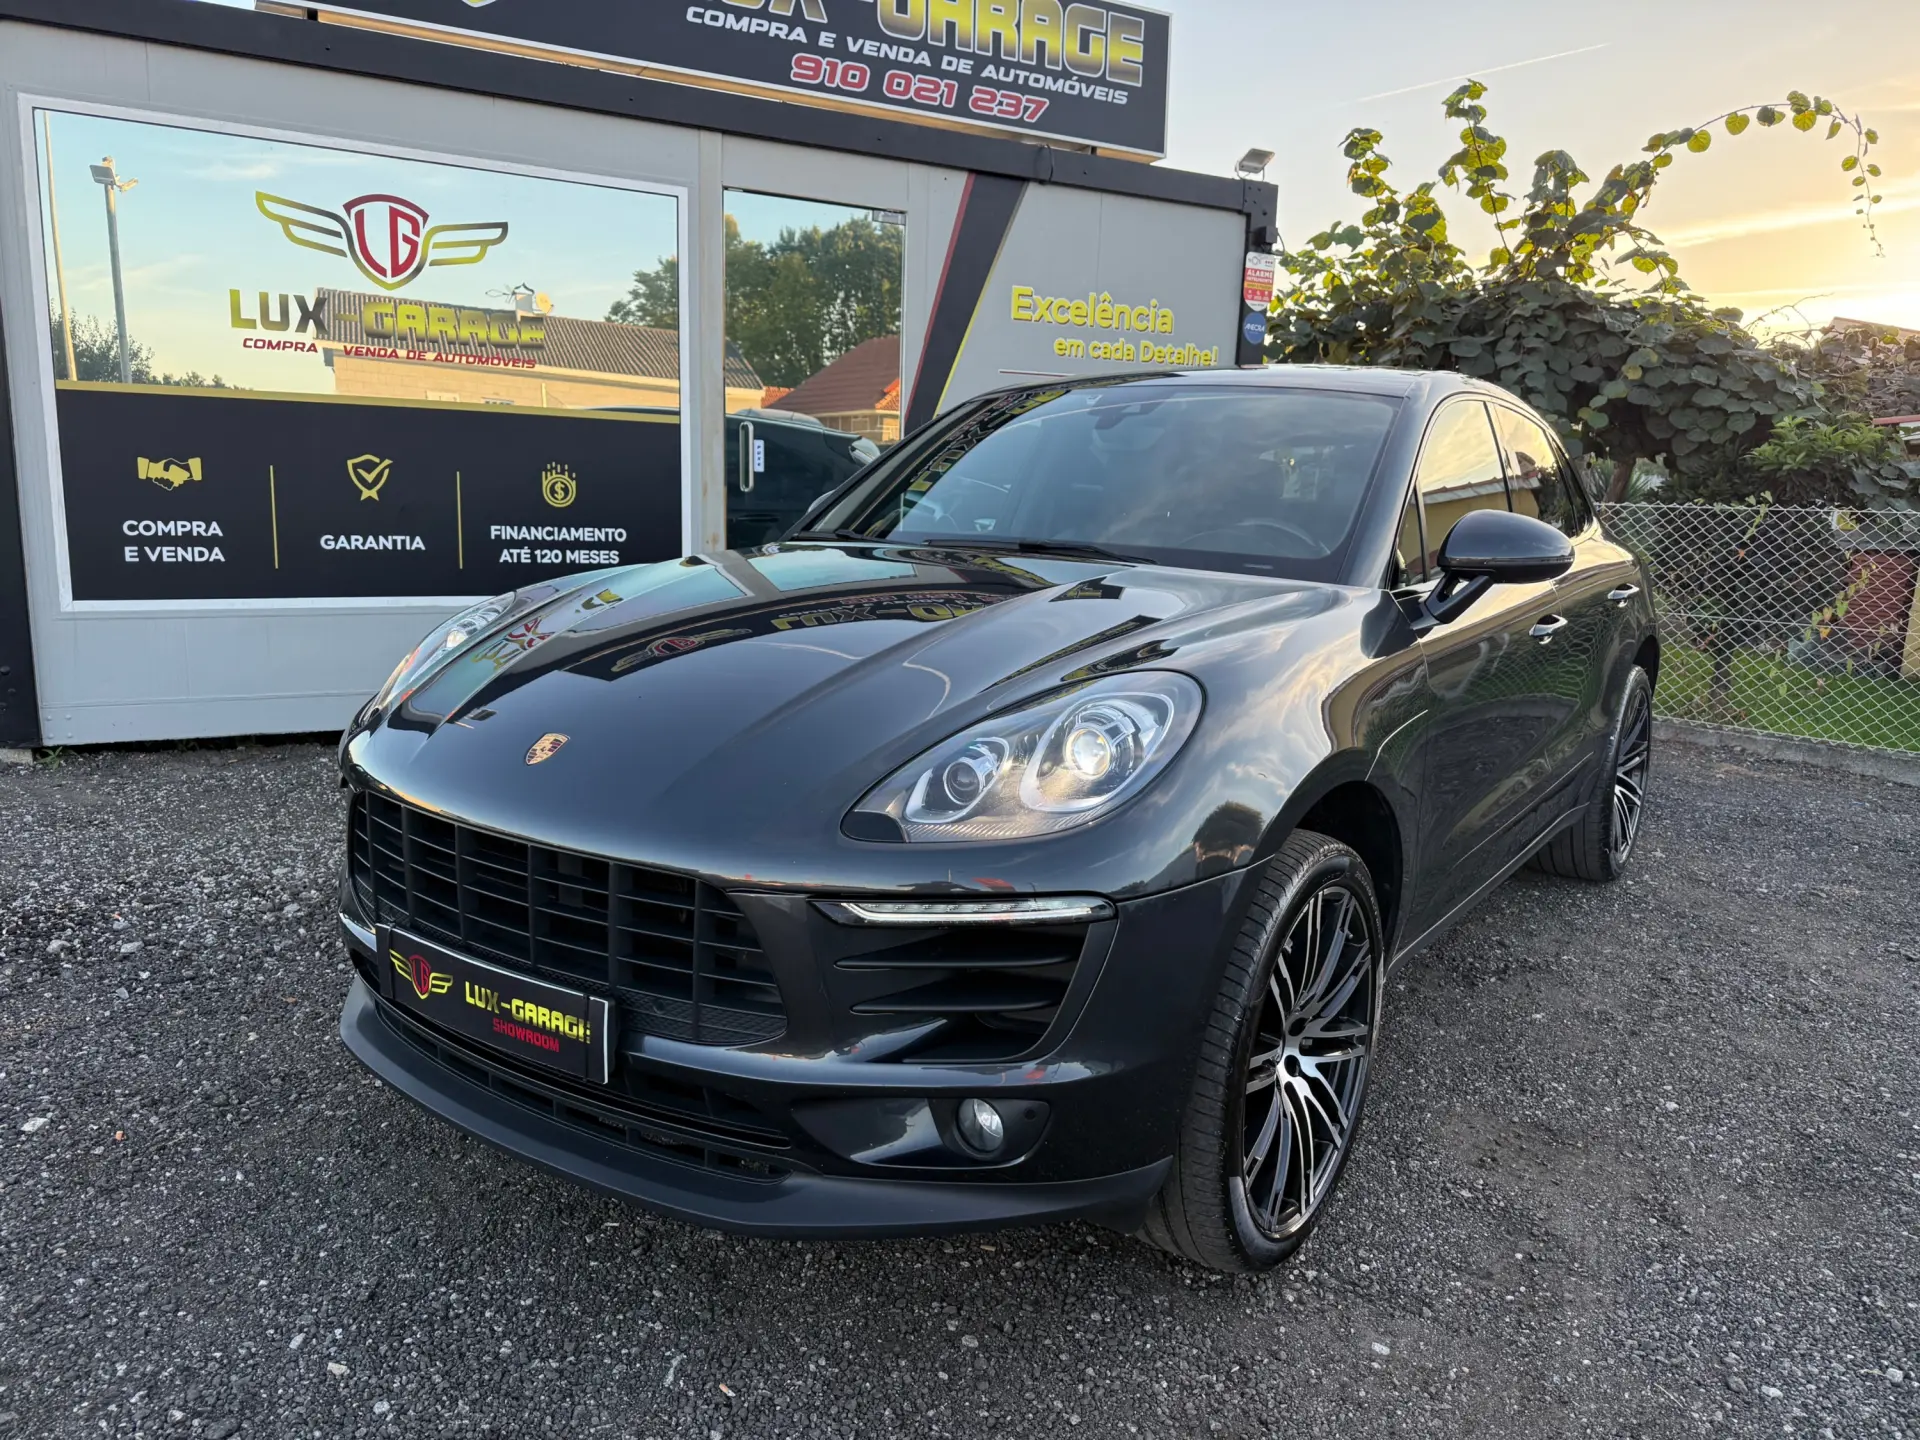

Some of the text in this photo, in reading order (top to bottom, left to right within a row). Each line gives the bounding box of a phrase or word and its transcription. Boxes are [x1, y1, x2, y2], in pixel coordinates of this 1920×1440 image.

[685, 6, 1128, 105] COMPRA E VENDA DE AUTOMÓVEIS
[790, 53, 1050, 123] 910 021 237
[1010, 285, 1175, 334] Excelência
[243, 337, 537, 369] COMPRA VENDA DE AUTOMÓVEIS
[1053, 337, 1219, 367] em cada Detalhe!
[122, 520, 224, 537] COMPRA
[320, 534, 426, 550] GARANTIA
[490, 525, 627, 542] FINANCIAMENTO
[124, 546, 226, 562] E VENDA
[499, 546, 620, 564] ATÉ 120 MESES
[492, 1018, 560, 1053] SHOWROOM
